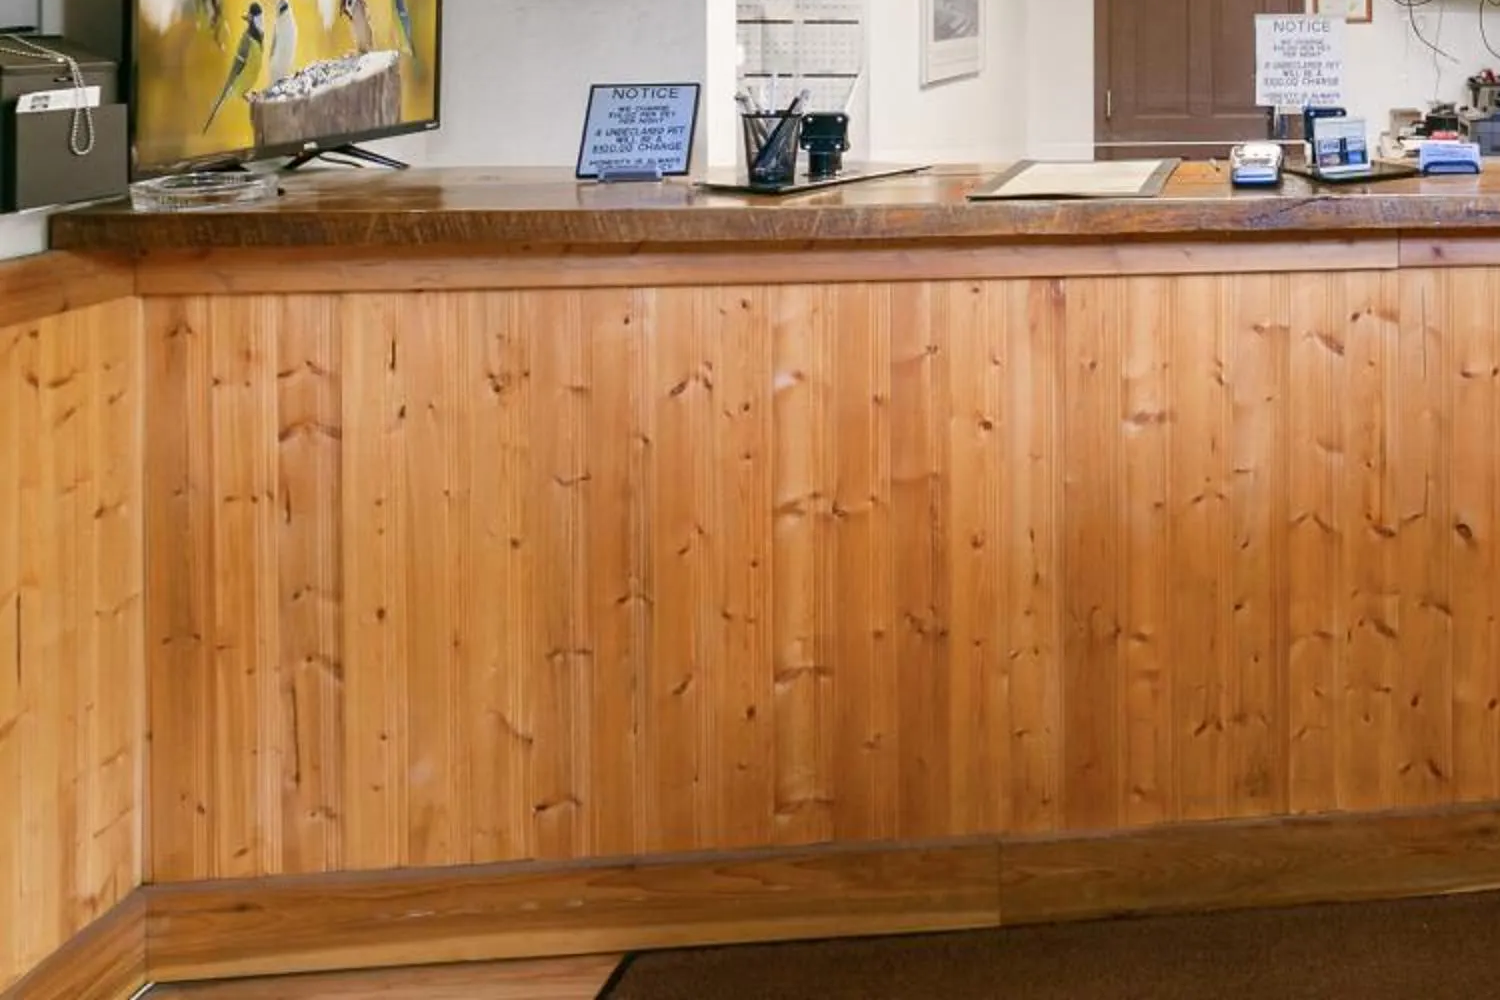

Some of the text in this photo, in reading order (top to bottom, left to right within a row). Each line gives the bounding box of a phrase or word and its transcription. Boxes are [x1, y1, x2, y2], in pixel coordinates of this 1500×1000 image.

[1273, 21, 1330, 33] NOTICE
[612, 87, 679, 99] NOTICE
[637, 142, 682, 151] CHARGE
